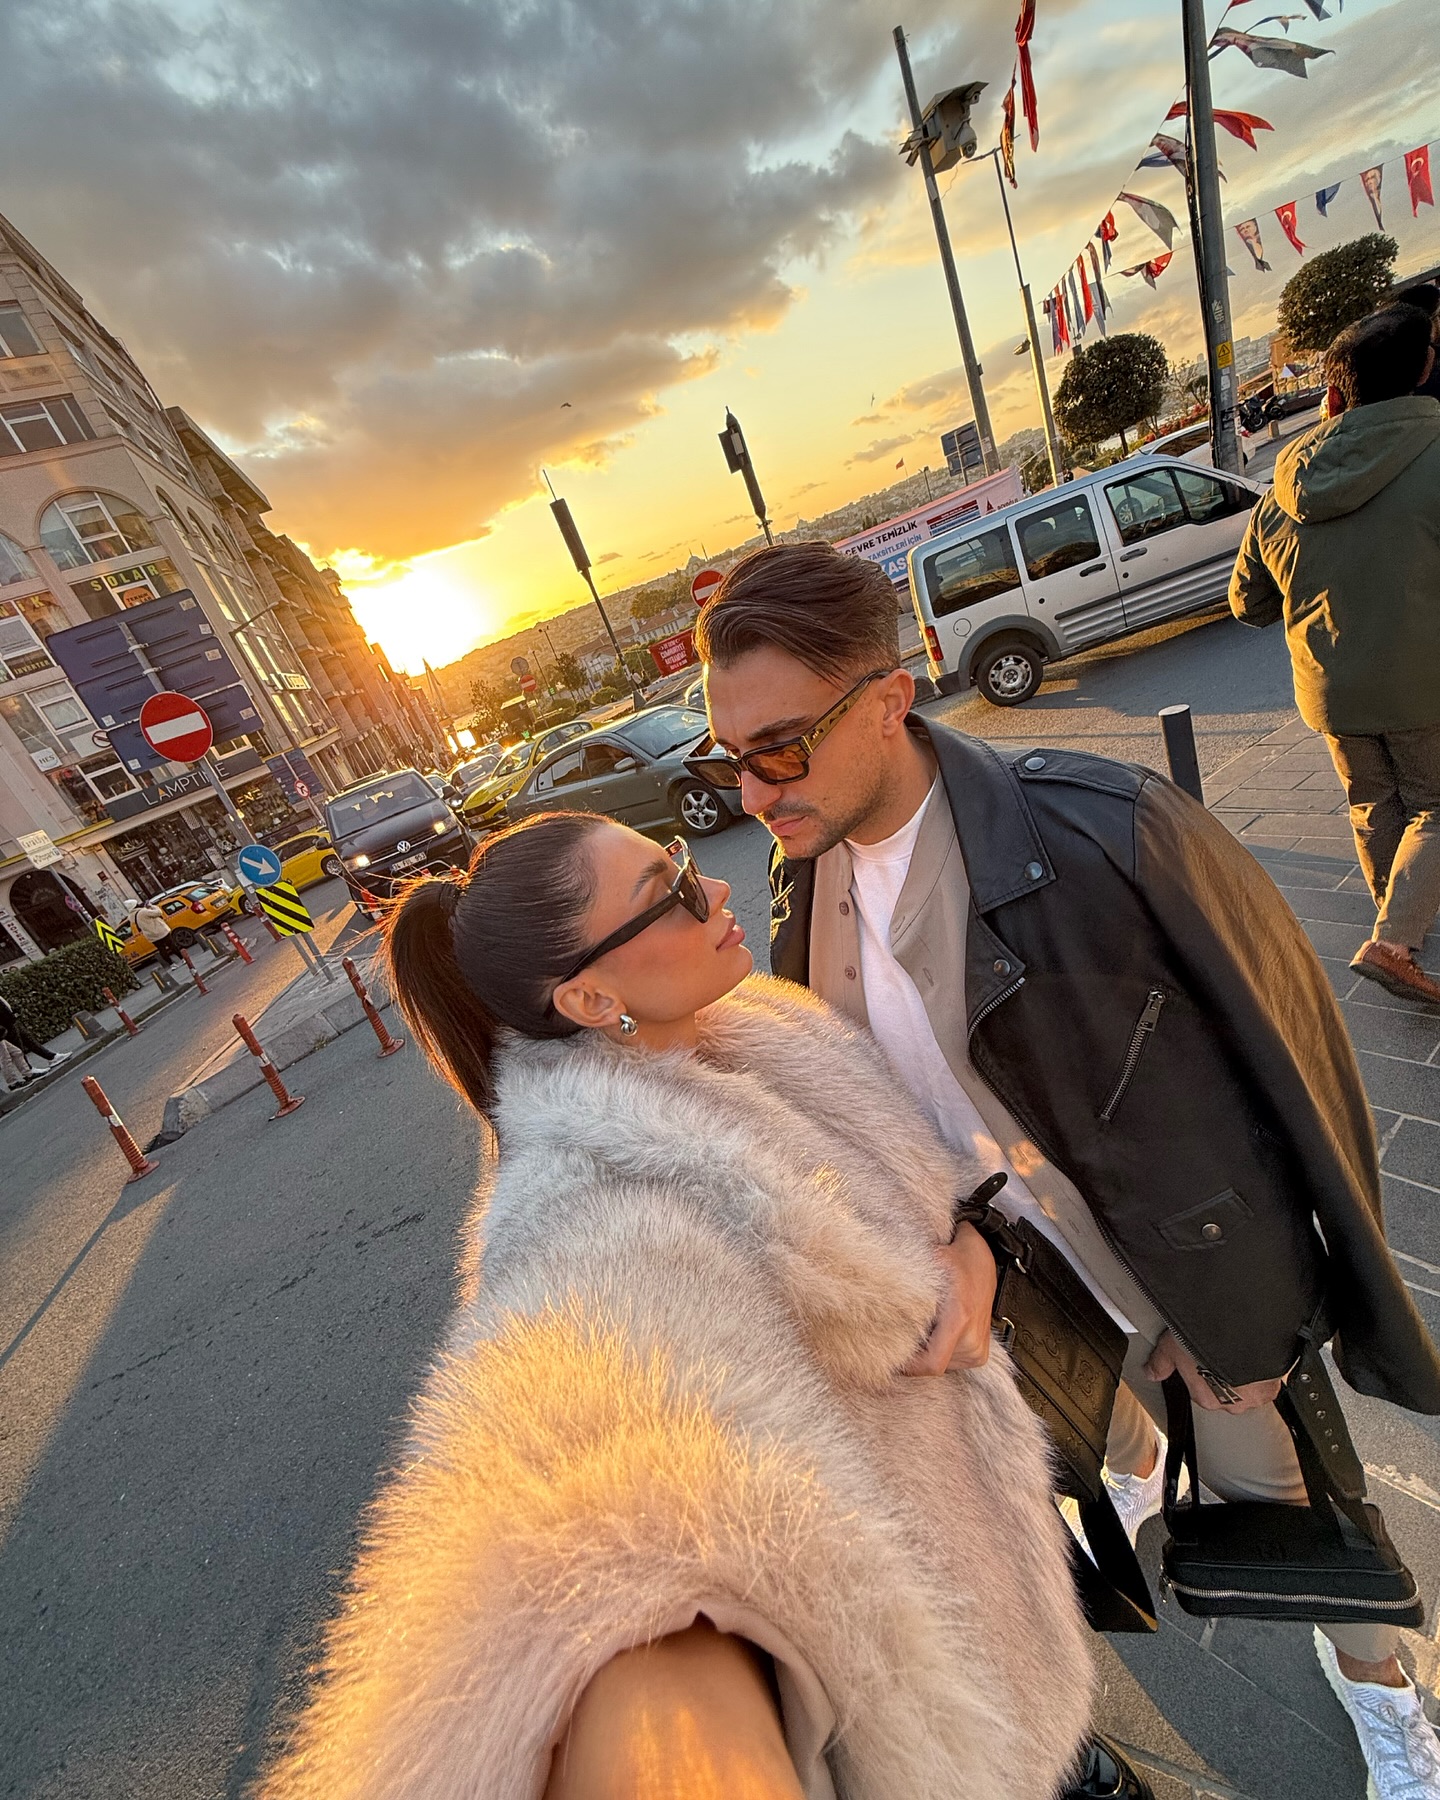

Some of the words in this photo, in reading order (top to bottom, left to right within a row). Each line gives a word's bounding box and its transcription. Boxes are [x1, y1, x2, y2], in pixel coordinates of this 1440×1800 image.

[876, 520, 918, 545] TEMİZLİK
[907, 533, 923, 546] İÇİN
[90, 564, 160, 592] SOLAR
